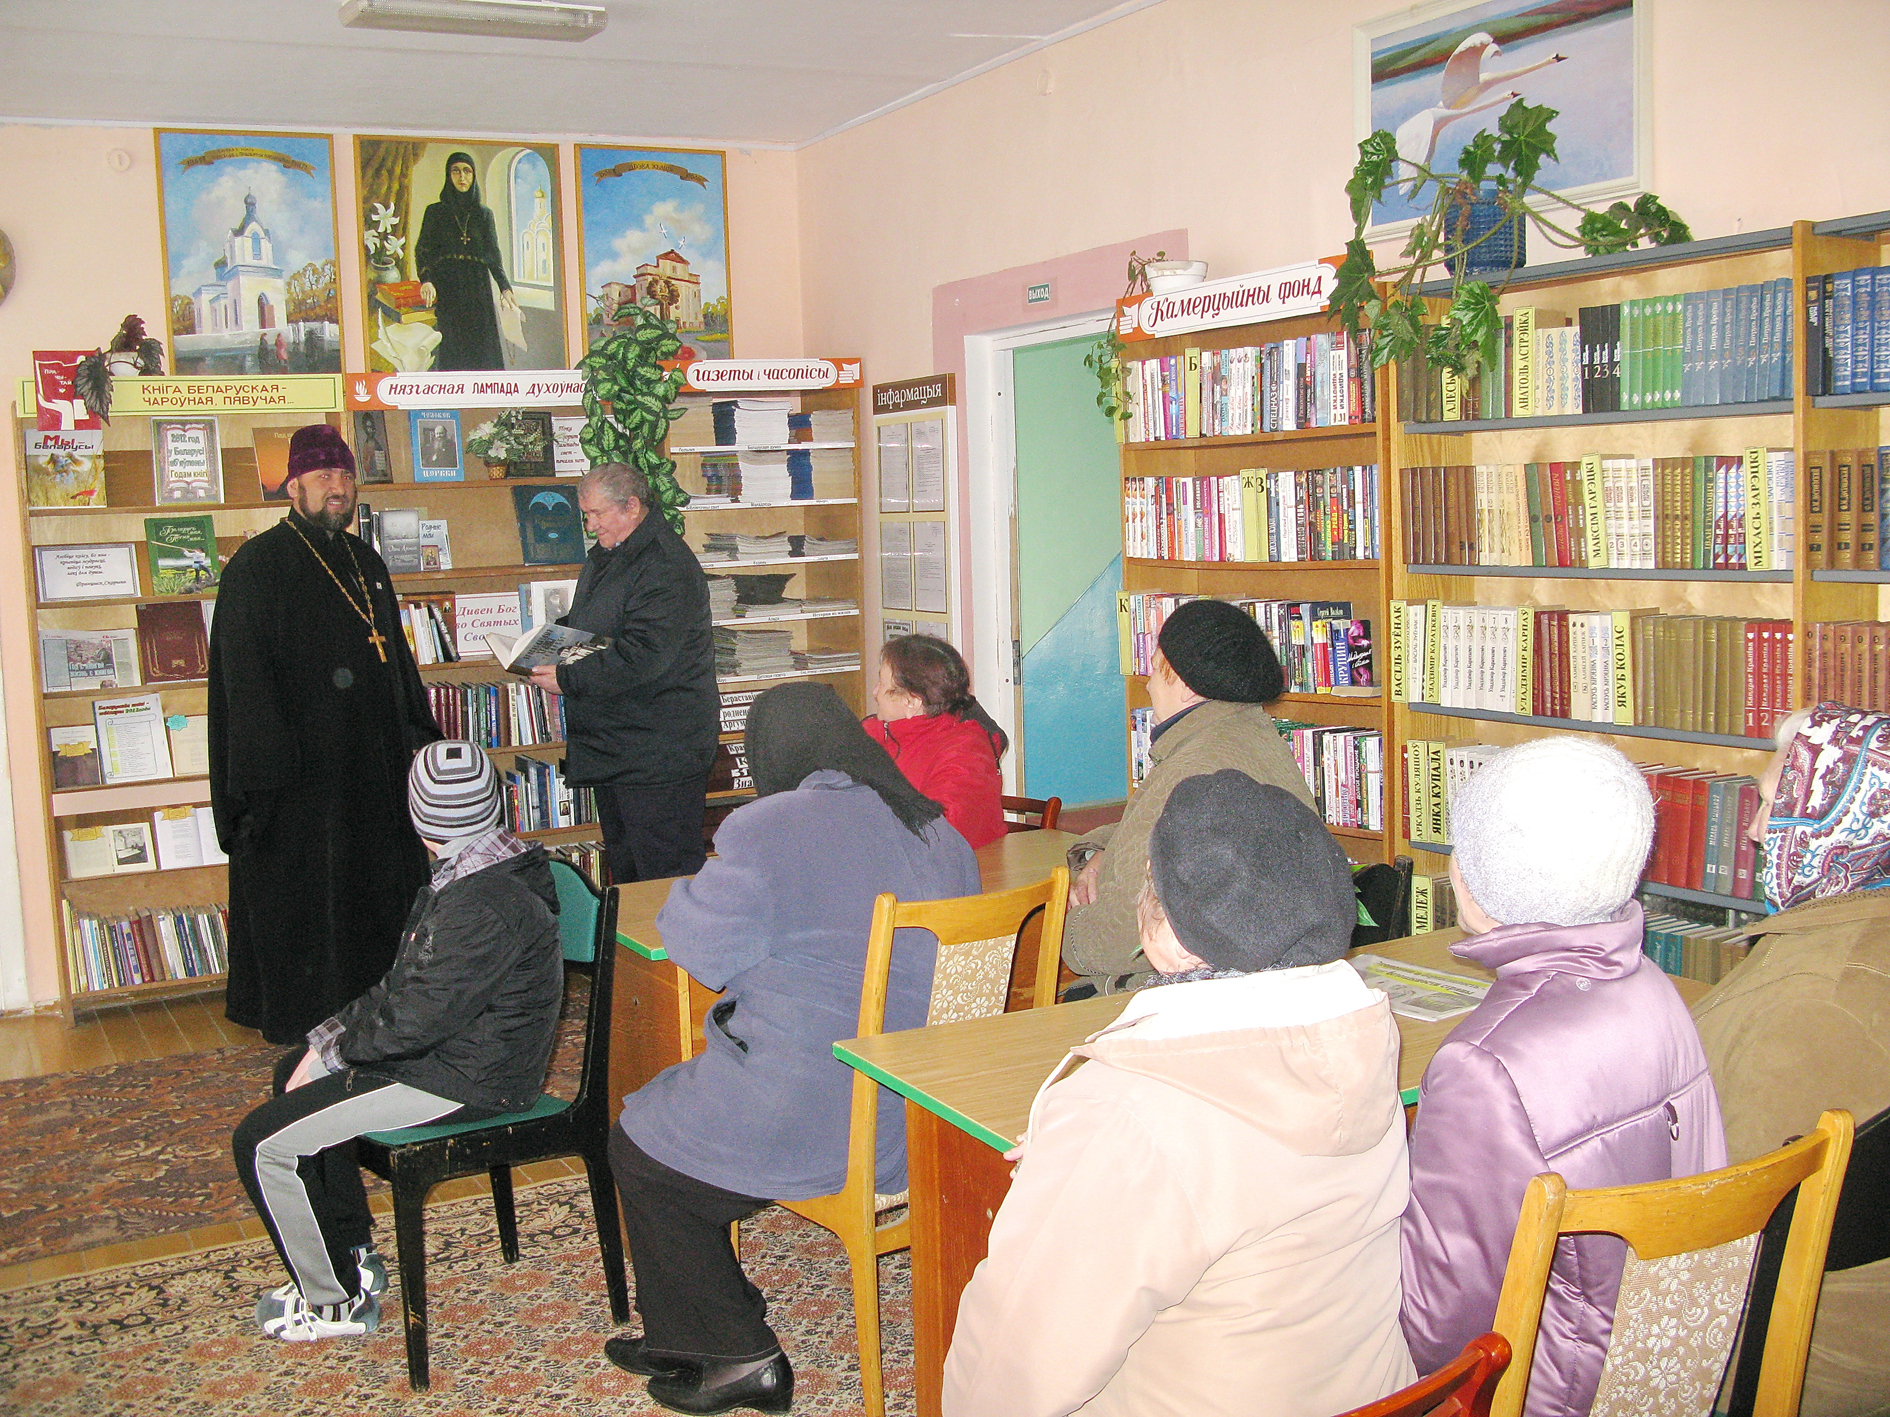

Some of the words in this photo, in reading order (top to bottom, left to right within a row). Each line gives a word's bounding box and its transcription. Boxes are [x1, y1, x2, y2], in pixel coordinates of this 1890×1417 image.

[1029, 287, 1049, 300] ВЫХОД
[1149, 280, 1272, 328] Камерцыйны
[1278, 275, 1323, 306] фонд
[1516, 311, 1529, 362] АСТРЭЙКА
[1710, 325, 1718, 351] Патрусь
[1749, 321, 1758, 347] Патрусь
[1762, 318, 1770, 344] Патрусь
[1774, 317, 1783, 343] Патрусь
[692, 365, 754, 382] газеты
[763, 364, 831, 382] часопісы
[1188, 355, 1198, 372] Б
[1584, 367, 1589, 379] 1
[1594, 365, 1601, 378] 2
[1602, 364, 1609, 378] 3
[1612, 363, 1621, 378] 4
[142, 384, 182, 394] КНІГА
[188, 384, 279, 395] БЕЛАРУСКАЯ
[472, 382, 520, 395] ЛАМПАДА
[526, 380, 586, 397] духоўнас
[877, 383, 943, 407] інфармацыя
[1518, 364, 1529, 410] АНАТОЛЬ
[1270, 391, 1279, 429] СПЕЦНАЗ
[1243, 476, 1254, 489] Ж
[1256, 476, 1265, 493] З
[1586, 462, 1598, 509] ГАРЭЦКІ
[1749, 450, 1763, 508] ЗАРЭЦКІ
[1589, 511, 1602, 558] МАКСІМ
[1610, 541, 1614, 549] 2
[1619, 541, 1625, 549] 3
[1751, 511, 1764, 567] МІХАСЬ
[456, 606, 493, 617] Дивен
[497, 604, 518, 614] Бог
[1119, 598, 1129, 612] К
[471, 618, 520, 629] Святых
[1391, 606, 1402, 652] ЗУЁНАК
[1429, 604, 1437, 654] КАРАТКЕВІЧ
[1520, 609, 1529, 652] КАРПАЎ
[464, 632, 486, 642] Сво
[1614, 626, 1625, 670] КОЛАС
[1336, 642, 1349, 684] КРУПИН
[1394, 654, 1403, 696] ВАСІЛЬ
[1428, 655, 1436, 698] УЛАДЗІМІР
[1520, 655, 1528, 712] УЛАДЗІМІР
[721, 692, 757, 705] Бераставі
[1616, 673, 1627, 708] ЯКУБ
[723, 719, 746, 730] Аргум
[1746, 712, 1754, 726] 1
[1760, 712, 1769, 725] 2
[1411, 743, 1421, 794] КУЛЯШОЎ
[1430, 750, 1442, 799] КУПАЛА
[1414, 797, 1423, 840] АРКАДЗЬ
[1431, 802, 1442, 835] ЯНКА
[1415, 886, 1428, 931] МЕЛЕЖ
